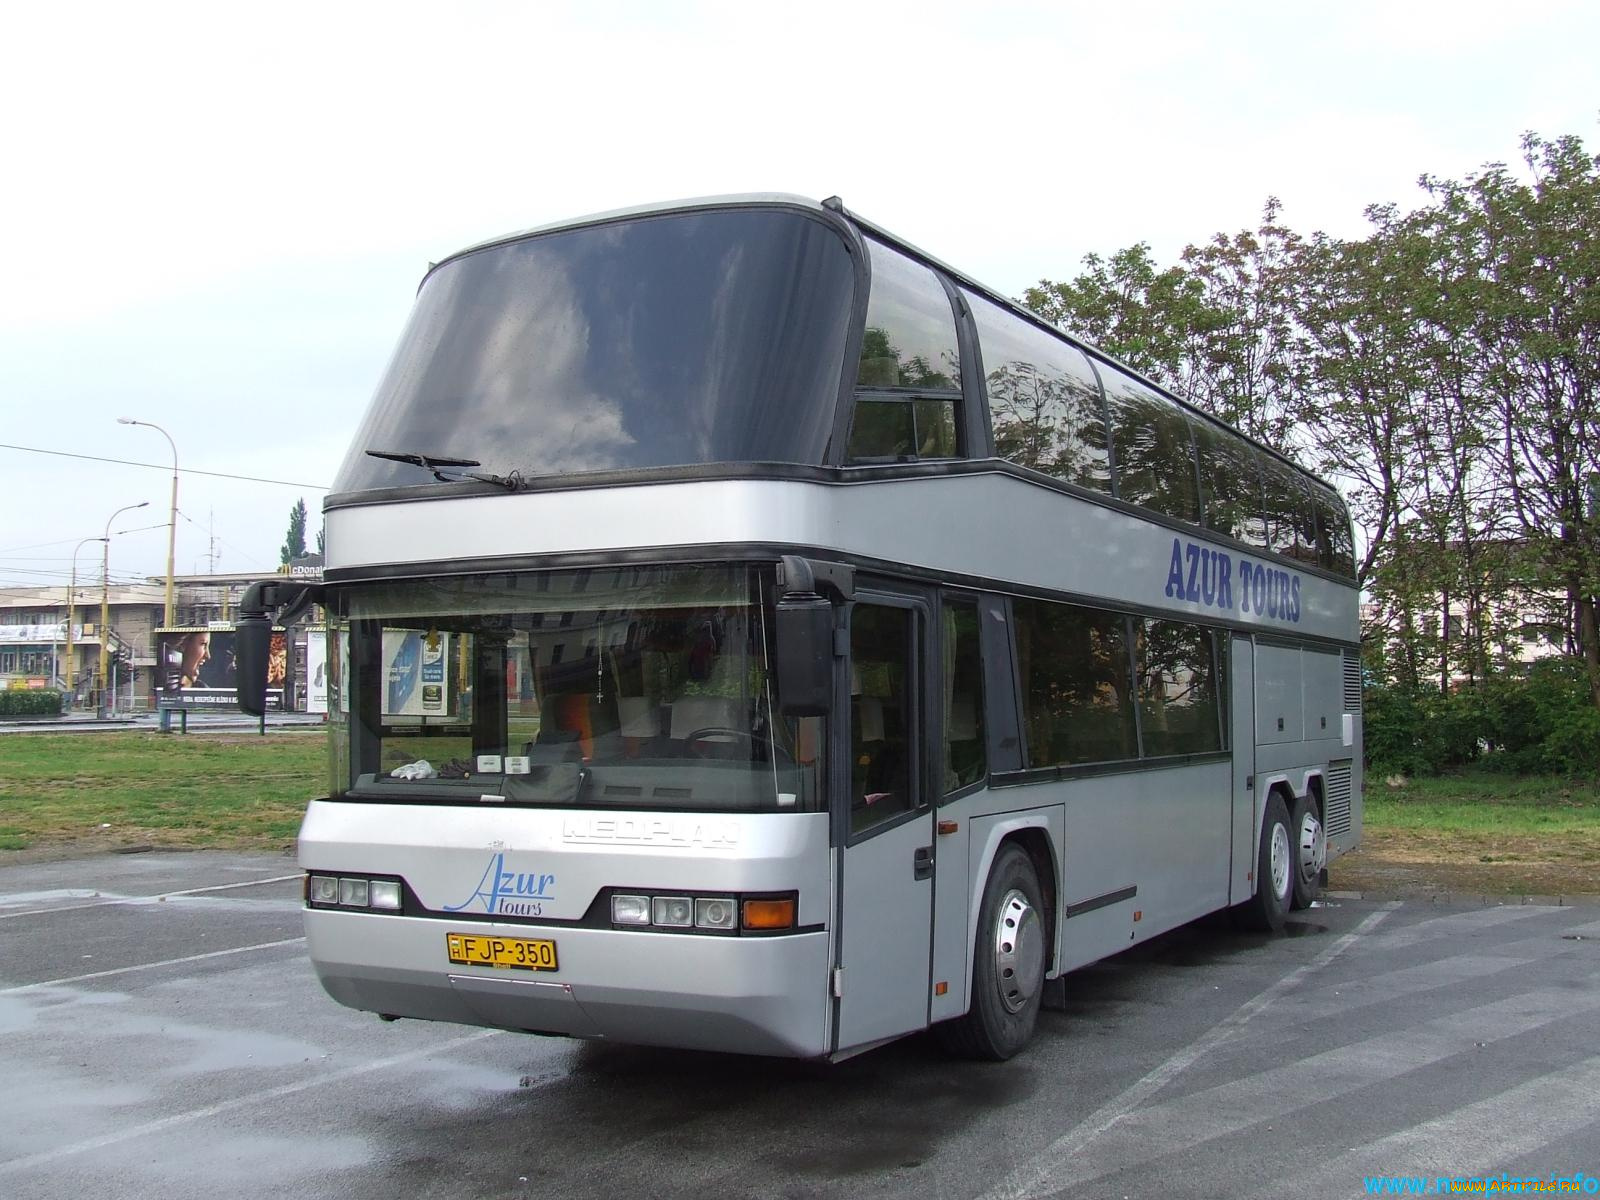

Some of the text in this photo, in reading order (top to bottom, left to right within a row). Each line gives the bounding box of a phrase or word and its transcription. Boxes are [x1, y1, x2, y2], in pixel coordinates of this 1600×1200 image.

[1165, 538, 1301, 623] AZUR TOURS
[562, 817, 740, 844] NEOPLAN
[443, 853, 555, 913] Azur
[499, 898, 542, 916] tours
[464, 939, 552, 965] FJP-350
